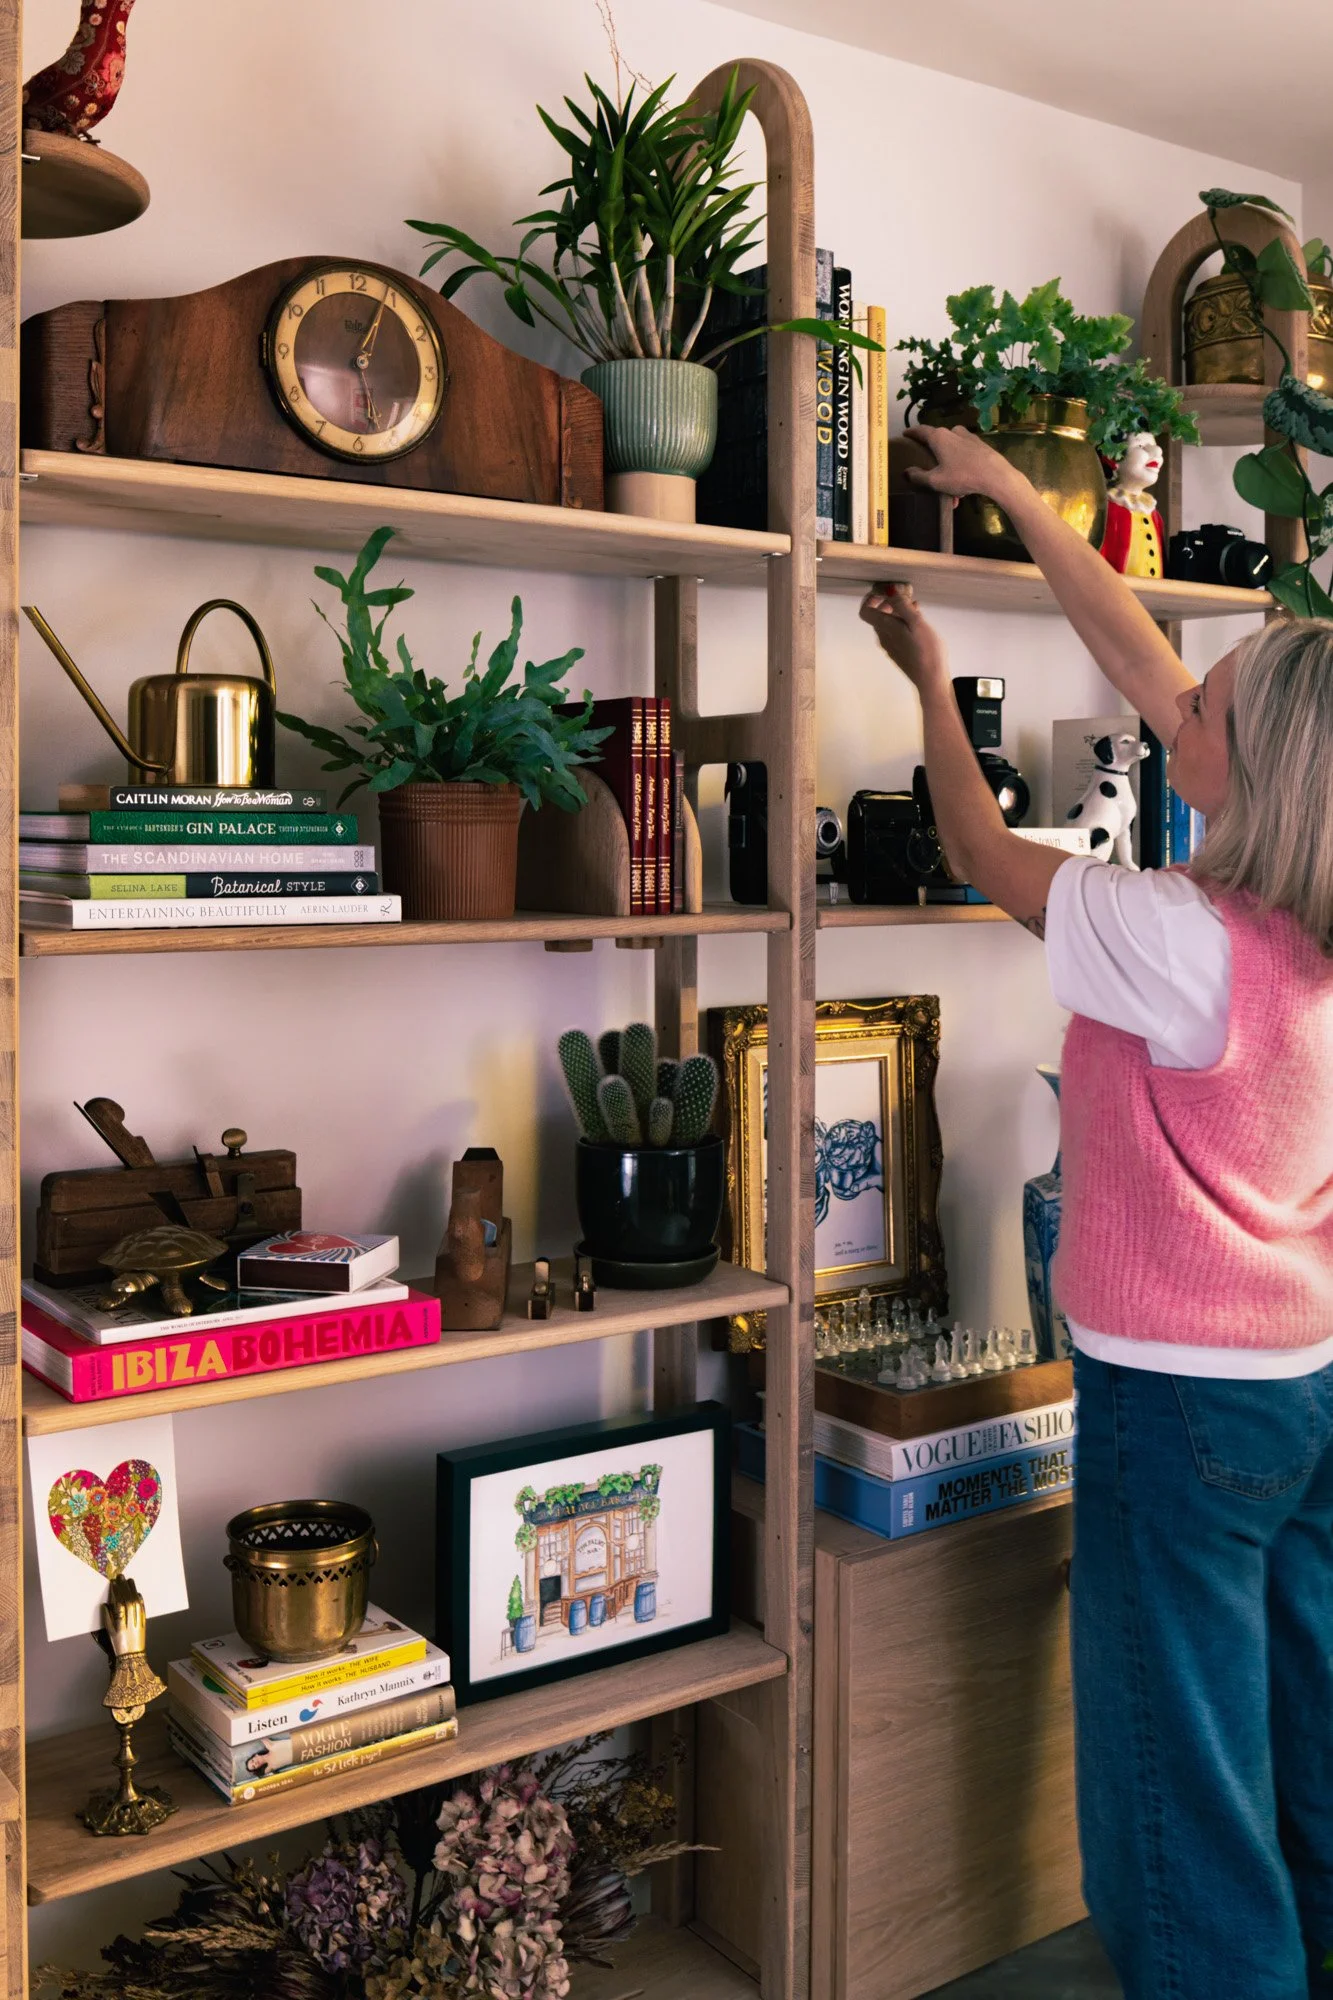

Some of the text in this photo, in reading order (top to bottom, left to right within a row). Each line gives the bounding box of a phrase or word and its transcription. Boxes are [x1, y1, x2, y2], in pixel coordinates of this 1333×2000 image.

[314, 278, 325, 296] 11
[349, 274, 367, 292] 12
[287, 303, 304, 319] 10
[415, 325, 427, 342] 2
[278, 342, 290, 360] 9
[424, 366, 436, 382] 3
[837, 283, 851, 459] WORING IN WOOD
[289, 386, 300, 402] 8
[817, 348, 833, 444] WOOD
[315, 420, 327, 436] 7
[352, 436, 364, 452] 6
[116, 793, 169, 805] CAITLIN
[170, 794, 212, 805] MORAN
[646, 808, 655, 825] Fairy
[661, 803, 670, 821] Fairy
[186, 822, 219, 835] GIN
[219, 822, 276, 835] PALACE
[662, 820, 670, 835] Tales
[102, 853, 128, 865] THE
[133, 851, 254, 865] SCANDINAVIAN
[260, 852, 304, 865] HOME
[110, 883, 178, 893] SELINA LAKE
[211, 875, 326, 898] Botanical STYLE
[88, 904, 369, 920] ENTERTAINING BEAUTIFULLY AERIN LAUDER
[112, 1339, 227, 1392] IBIZA
[231, 1310, 413, 1372] BOHEMIA
[999, 1408, 1075, 1449] FASHIO
[902, 1430, 983, 1473] VOGUE
[938, 1450, 1068, 1501] MOMENTS THAT
[925, 1488, 992, 1522] MATTER
[1000, 1478, 1028, 1497] THE
[301, 1683, 316, 1692] How
[345, 1671, 357, 1679] THE
[360, 1660, 391, 1675] HUSBAND
[304, 1672, 319, 1681] How
[349, 1660, 361, 1668] THE
[363, 1655, 379, 1664] WIFE
[247, 1676, 415, 1735] Listen Kathryn Mannix
[300, 1720, 352, 1748] VOGUE
[300, 1736, 353, 1762] FASHION
[323, 1762, 337, 1774] 52
